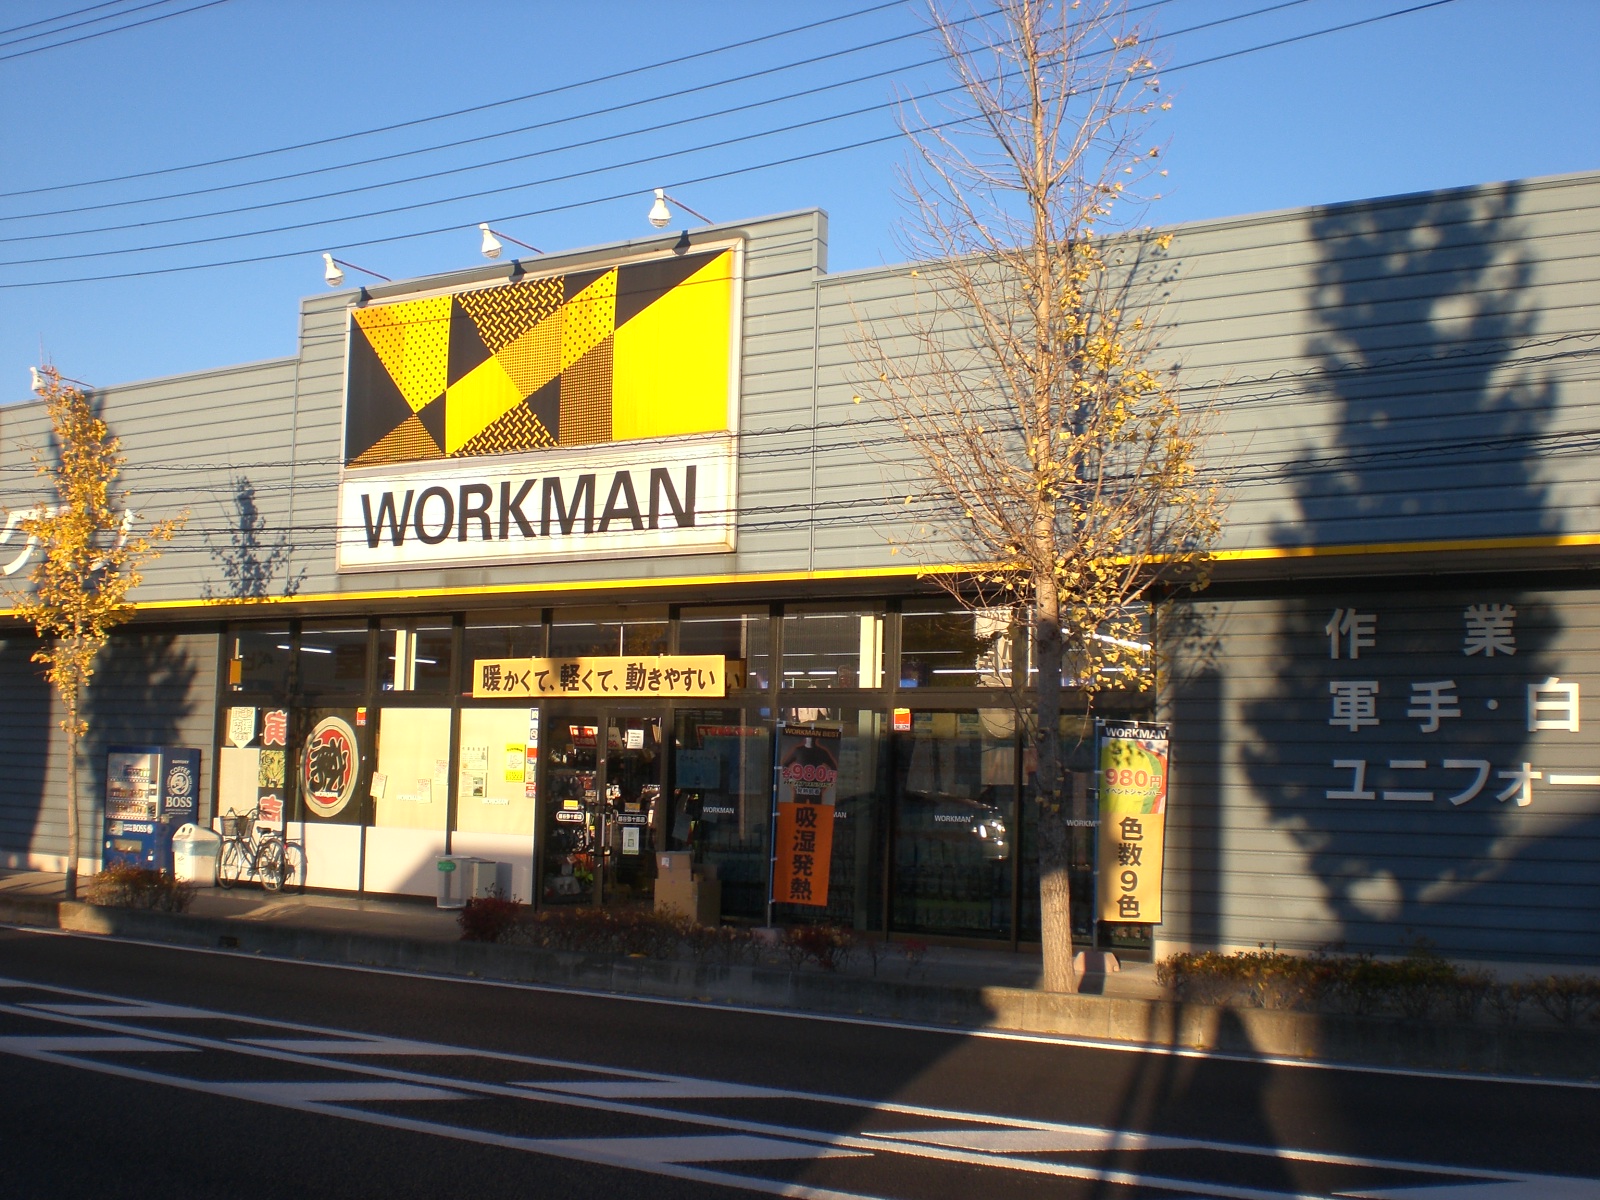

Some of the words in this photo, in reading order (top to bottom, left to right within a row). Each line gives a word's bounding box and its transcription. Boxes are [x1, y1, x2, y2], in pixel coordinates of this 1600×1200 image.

[361, 465, 697, 549] WORKMAN
[482, 662, 716, 692] 暖かくて、軽くて、動きやすい
[1329, 677, 1579, 733] 軍手・白
[784, 727, 822, 737] WORKMAN
[823, 730, 840, 738] BEST
[1106, 726, 1166, 740] WORKMAN
[169, 766, 190, 776] COFFEE
[1105, 768, 1162, 788] 980円
[1326, 759, 1600, 807] ユニフォー
[165, 796, 192, 808] BOSS
[702, 806, 734, 814] WORKMAN
[934, 815, 971, 823] WORKMAN
[1066, 819, 1095, 827] WORKM
[132, 824, 147, 833] BOSS
[790, 806, 818, 901] 吸湿発熱
[1116, 816, 1143, 919] 色数9色
